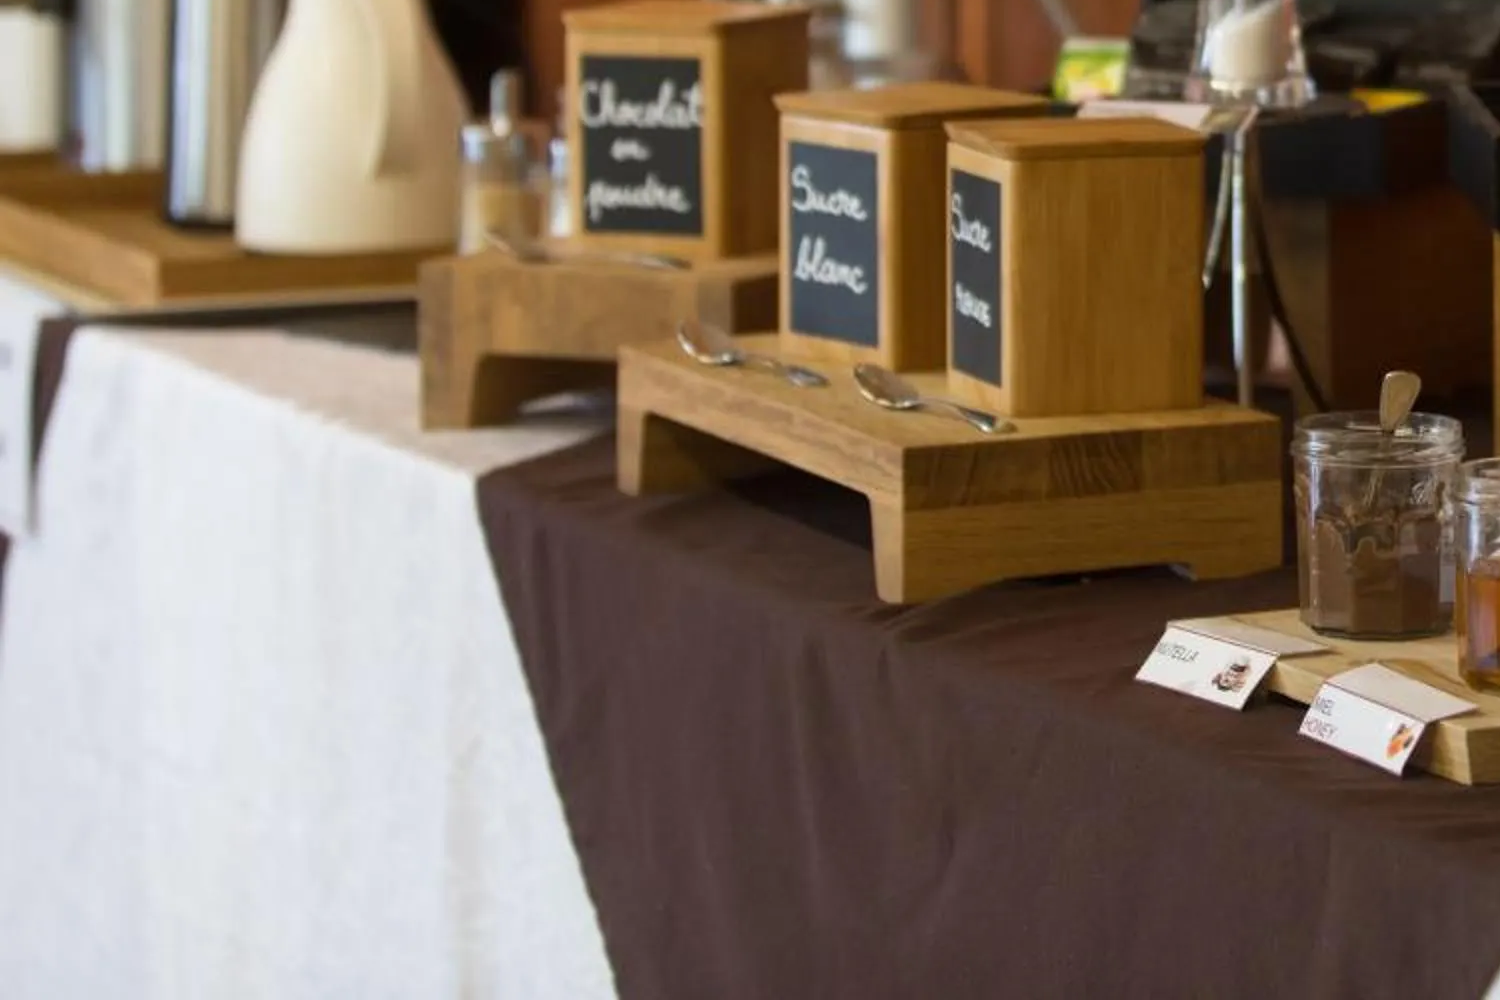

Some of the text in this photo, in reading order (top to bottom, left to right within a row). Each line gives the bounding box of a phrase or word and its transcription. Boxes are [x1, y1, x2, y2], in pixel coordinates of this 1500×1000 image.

[580, 77, 704, 129] Chocolat
[584, 172, 692, 224] poudre
[791, 163, 868, 222] Sucre
[950, 193, 992, 253] Sucre
[794, 234, 869, 295] blanc
[1303, 715, 1340, 740] HONEY
